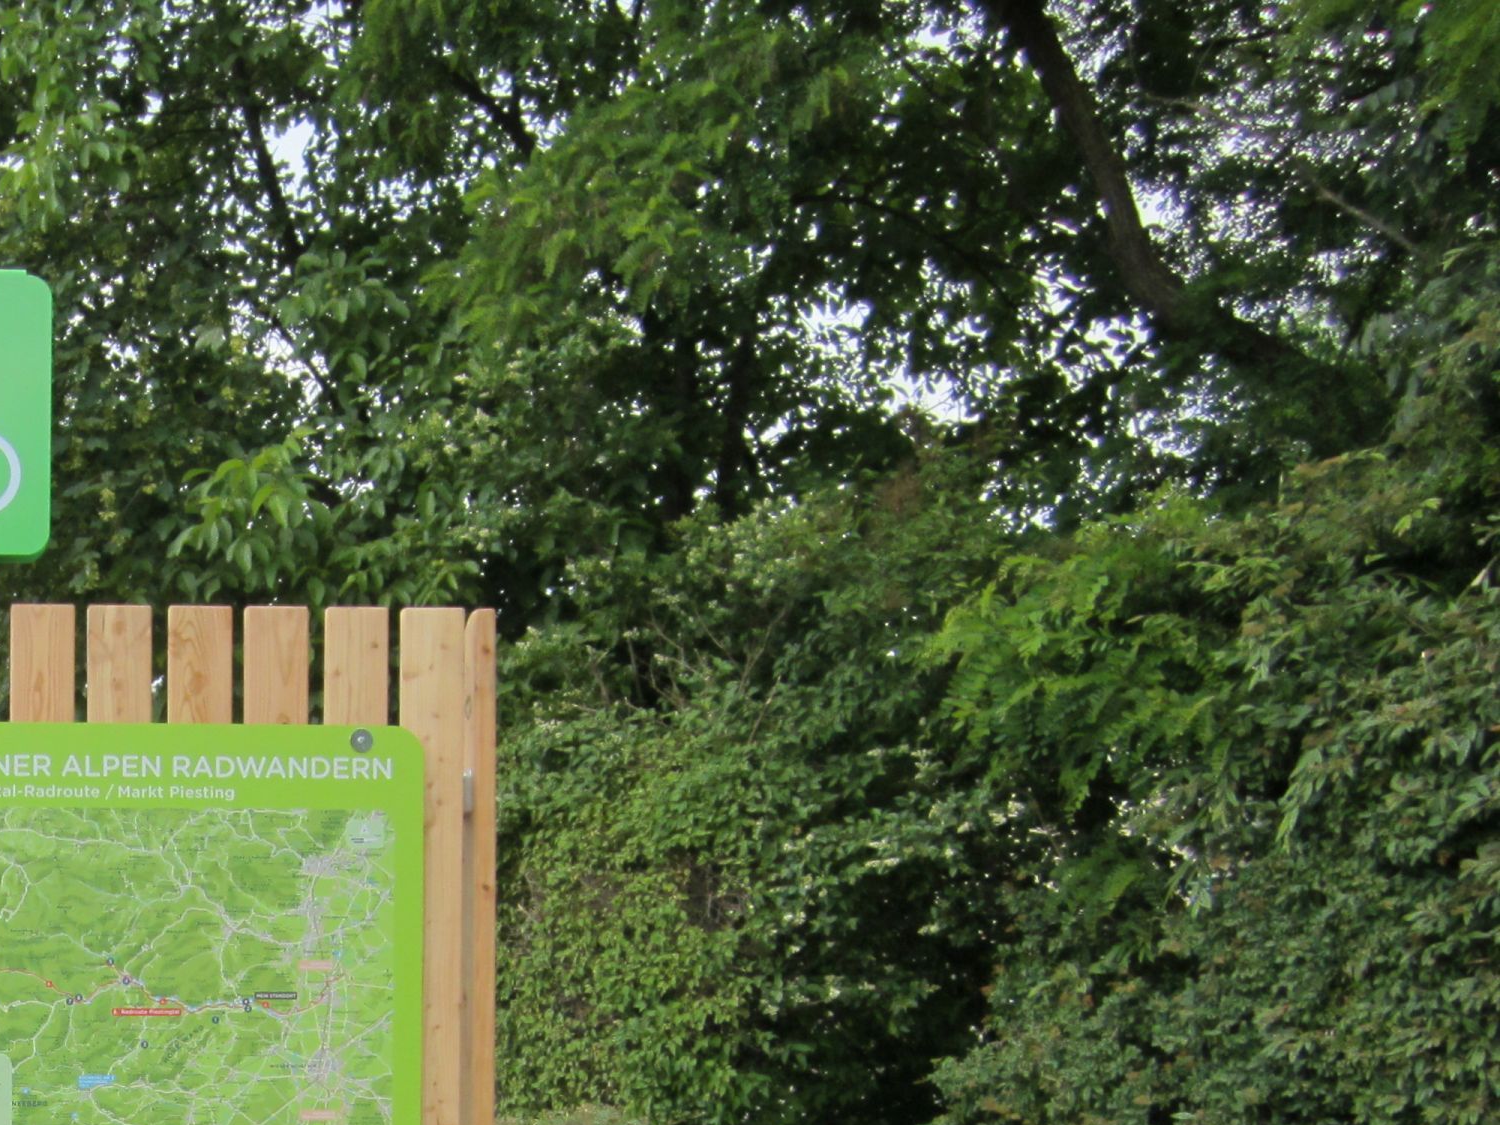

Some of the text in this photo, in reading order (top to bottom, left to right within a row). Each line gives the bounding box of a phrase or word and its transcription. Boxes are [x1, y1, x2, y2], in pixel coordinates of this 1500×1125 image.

[61, 755, 162, 778] ALPEN
[172, 755, 393, 780] RADWANDERN
[118, 785, 164, 799] Markt
[169, 786, 236, 801] Piesting
